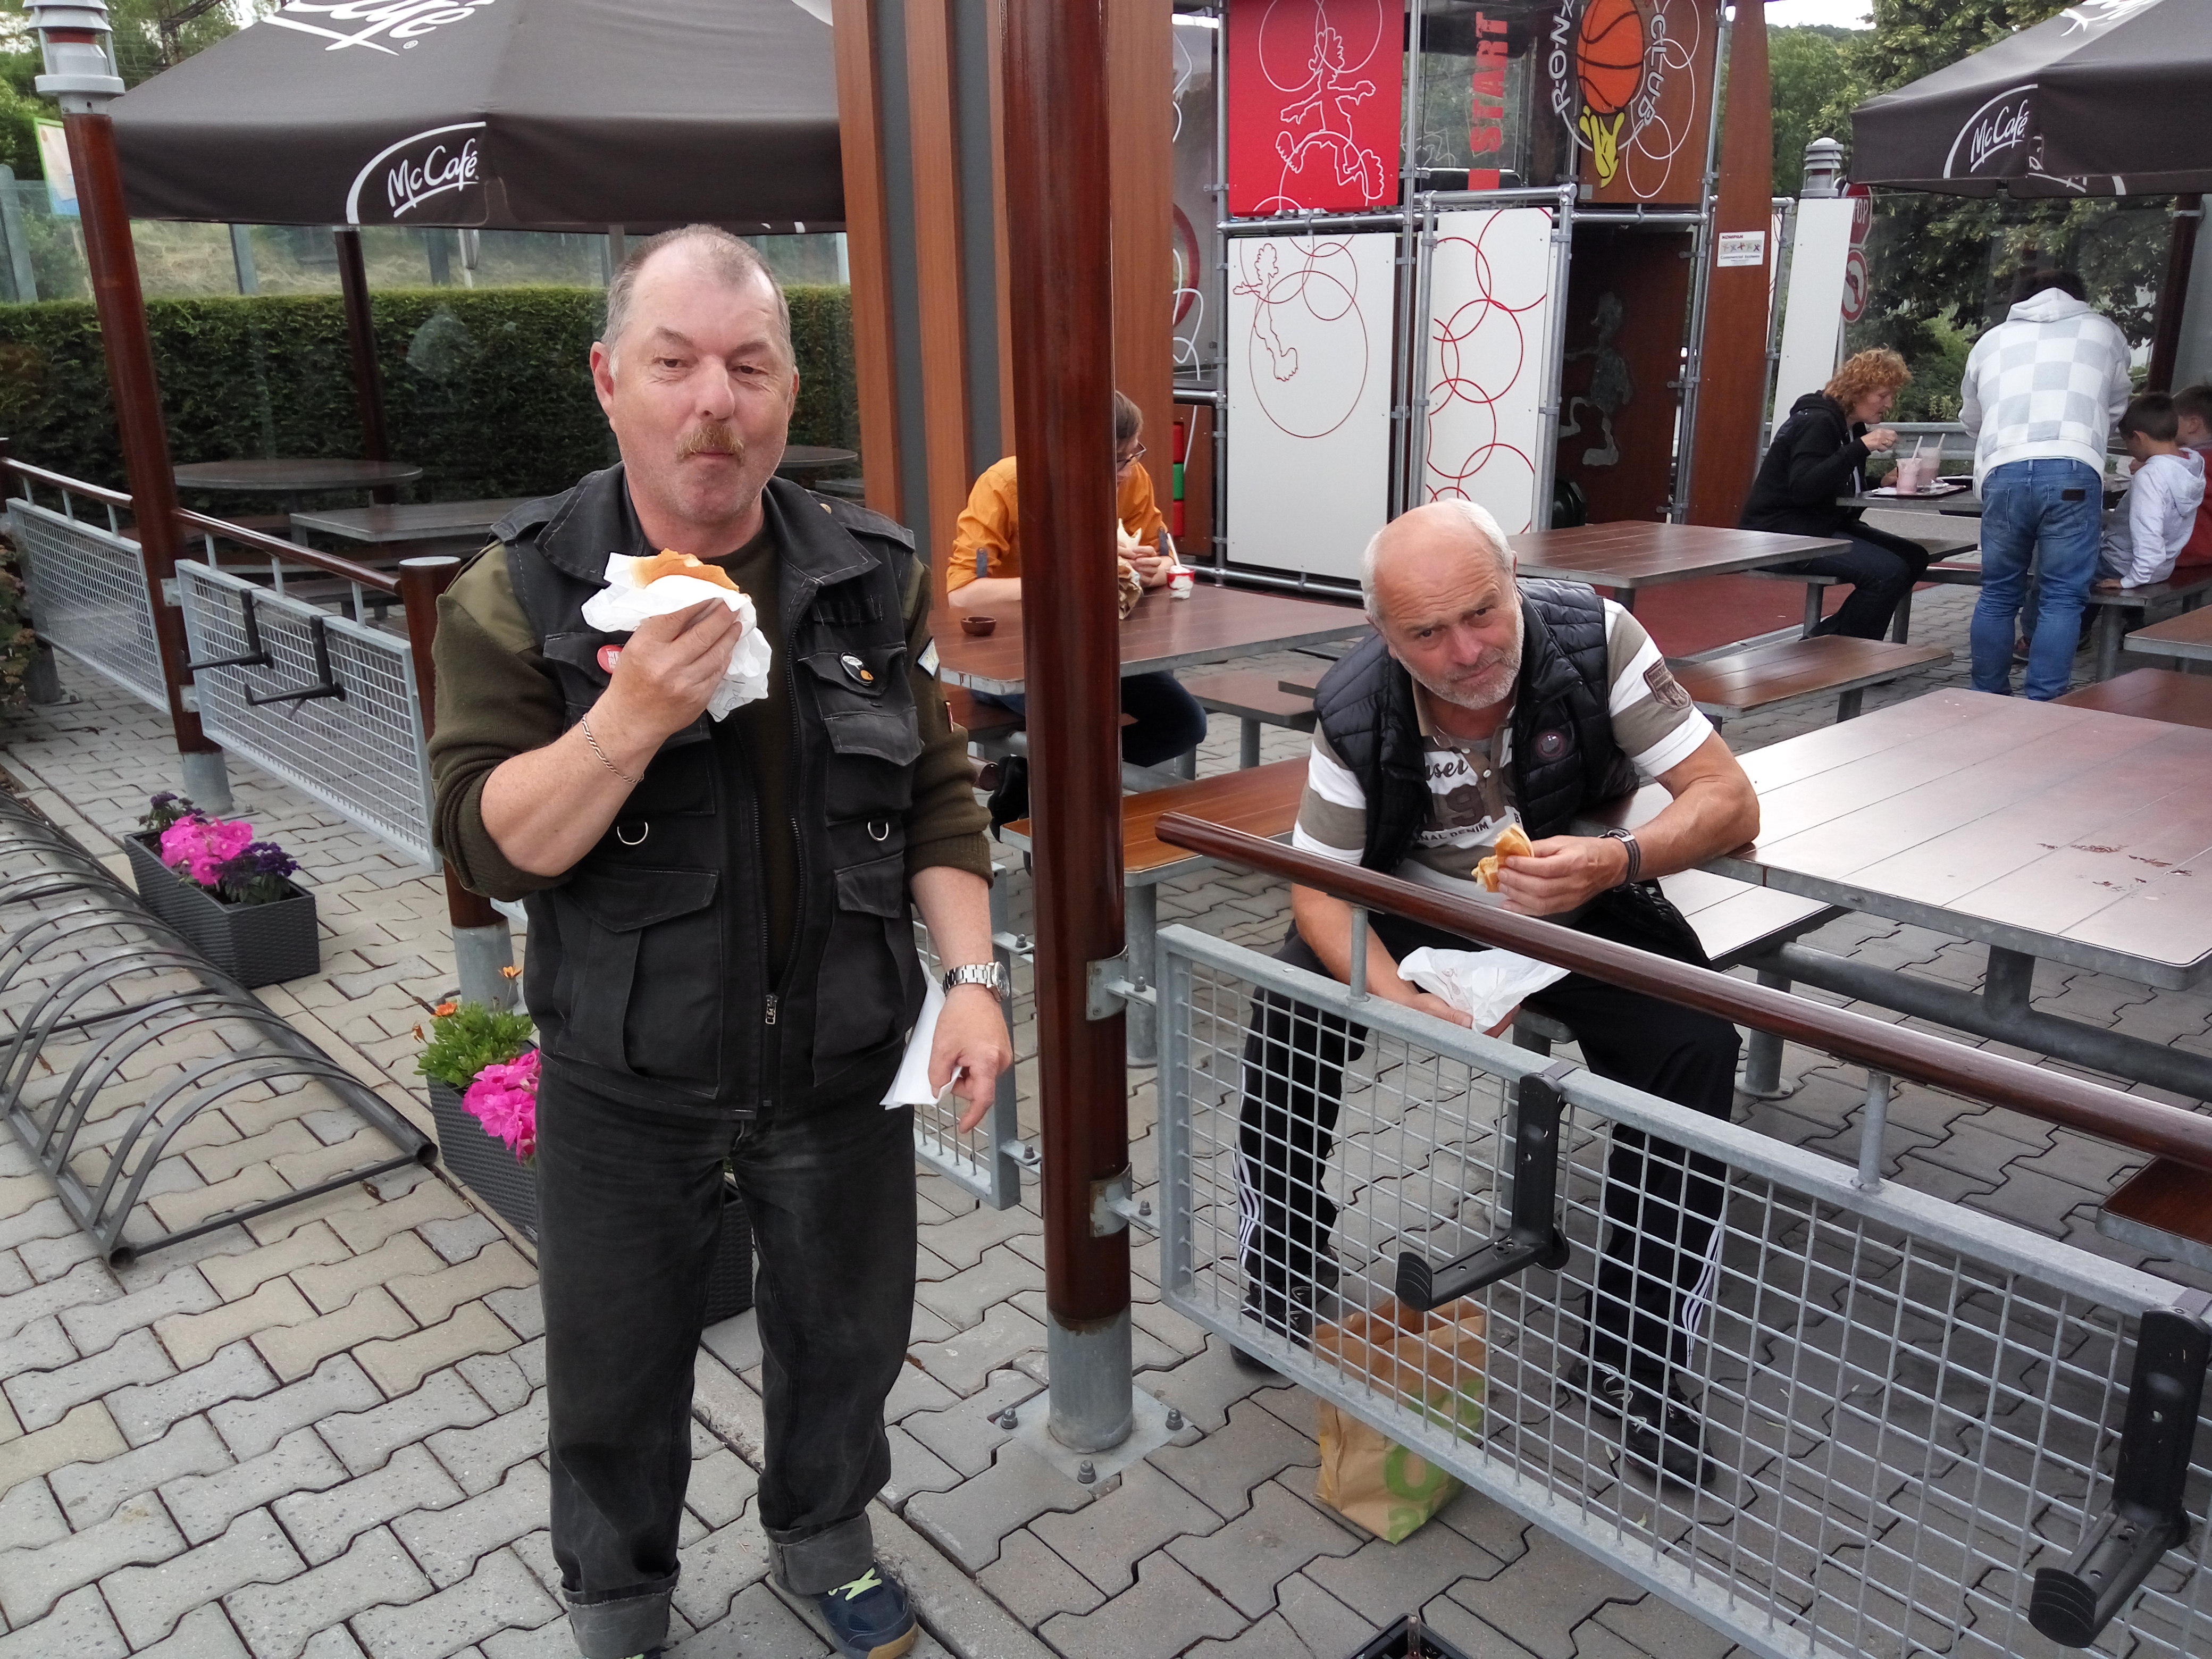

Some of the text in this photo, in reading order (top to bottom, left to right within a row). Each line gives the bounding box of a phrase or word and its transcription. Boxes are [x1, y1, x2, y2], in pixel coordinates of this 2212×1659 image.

[1469, 11, 1508, 152] START
[1637, 13, 1667, 125] CLUB
[1971, 99, 2030, 163] McCafé
[387, 138, 479, 209] McCafé
[1853, 198, 1869, 224] TOP
[1419, 821, 1489, 841] NAL DENIM
